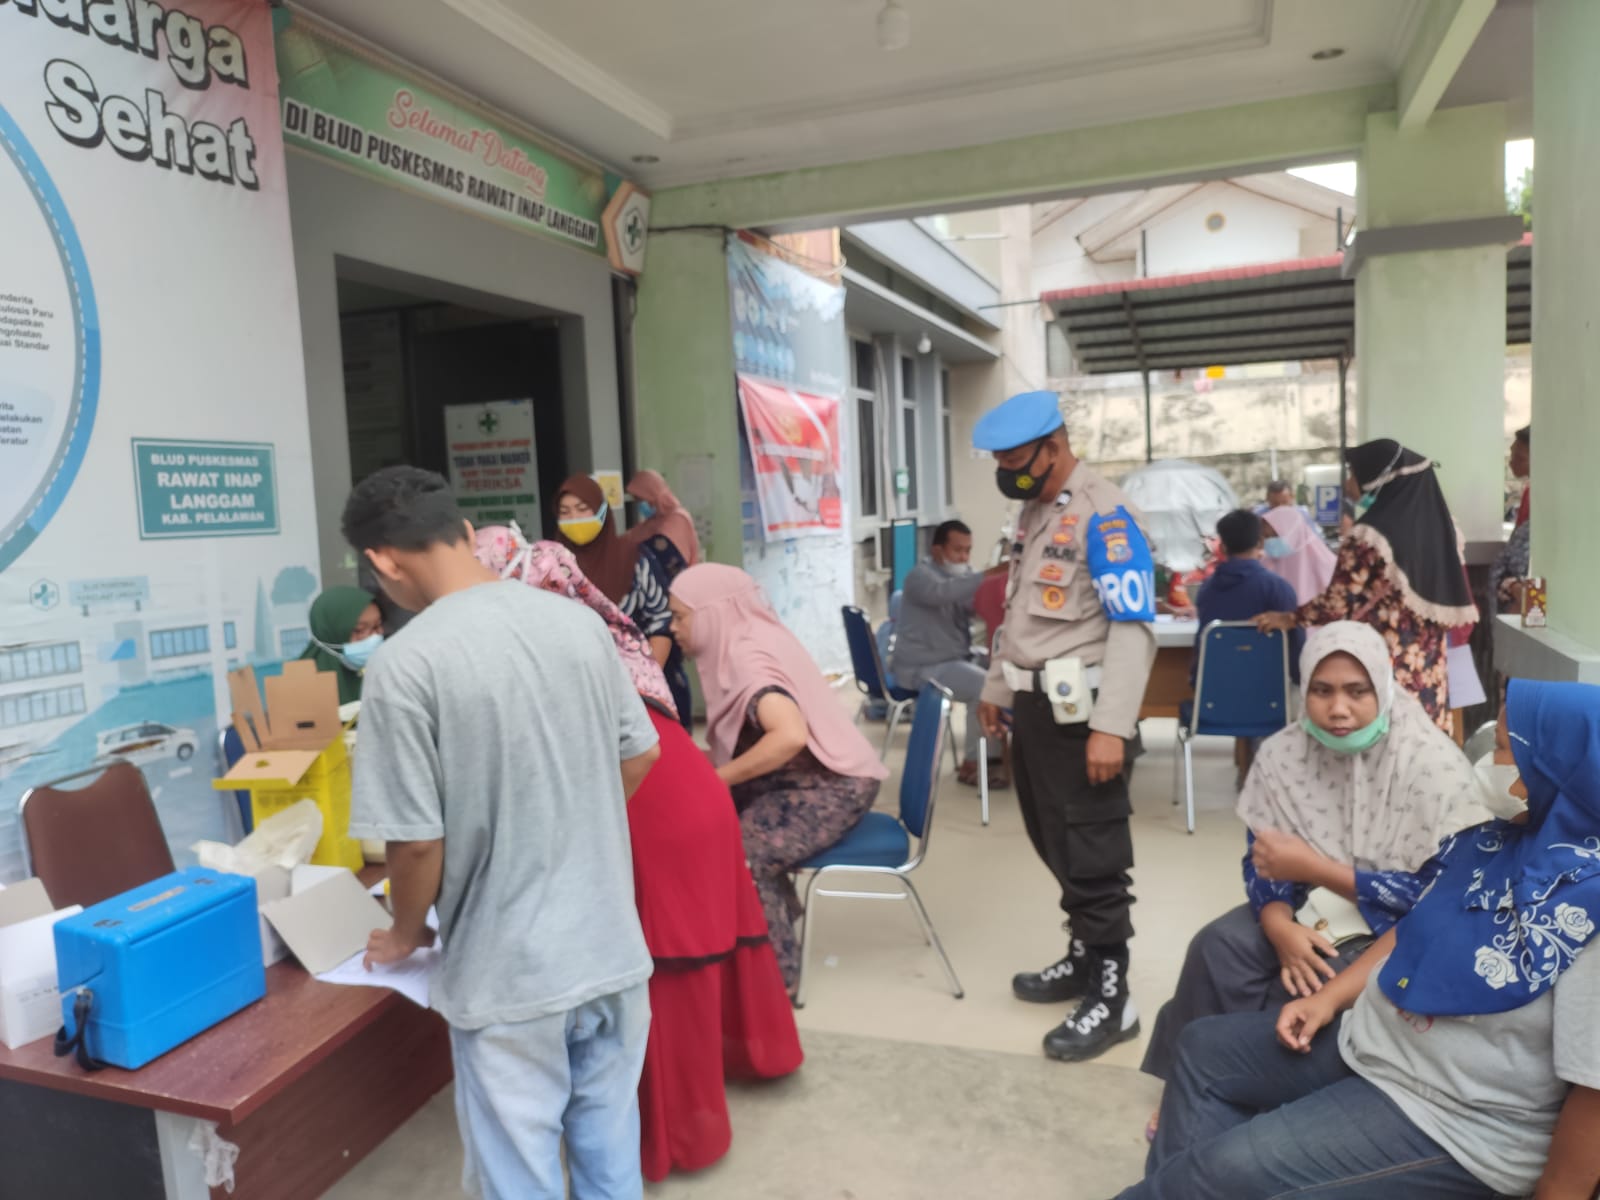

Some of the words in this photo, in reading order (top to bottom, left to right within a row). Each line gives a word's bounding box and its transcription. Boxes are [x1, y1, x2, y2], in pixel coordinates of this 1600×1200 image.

[44, 58, 260, 191] Sehat
[388, 90, 480, 153] Selamat
[480, 129, 546, 196] Datang
[285, 101, 308, 135] DI
[313, 112, 363, 155] BLUD
[366, 135, 465, 194] PUSKESMAS
[467, 175, 515, 213] RAWAT
[516, 195, 545, 223] INAP
[32, 306, 54, 319] Paru
[14, 339, 50, 351] Standar
[151, 453, 185, 466] BLUD
[188, 454, 259, 468] PUSKESMAS
[157, 472, 219, 487] RAWAT
[224, 473, 263, 488] INAP
[170, 493, 255, 509] LANGGAM
[1319, 486, 1337, 510] P
[162, 513, 192, 525] KAB.
